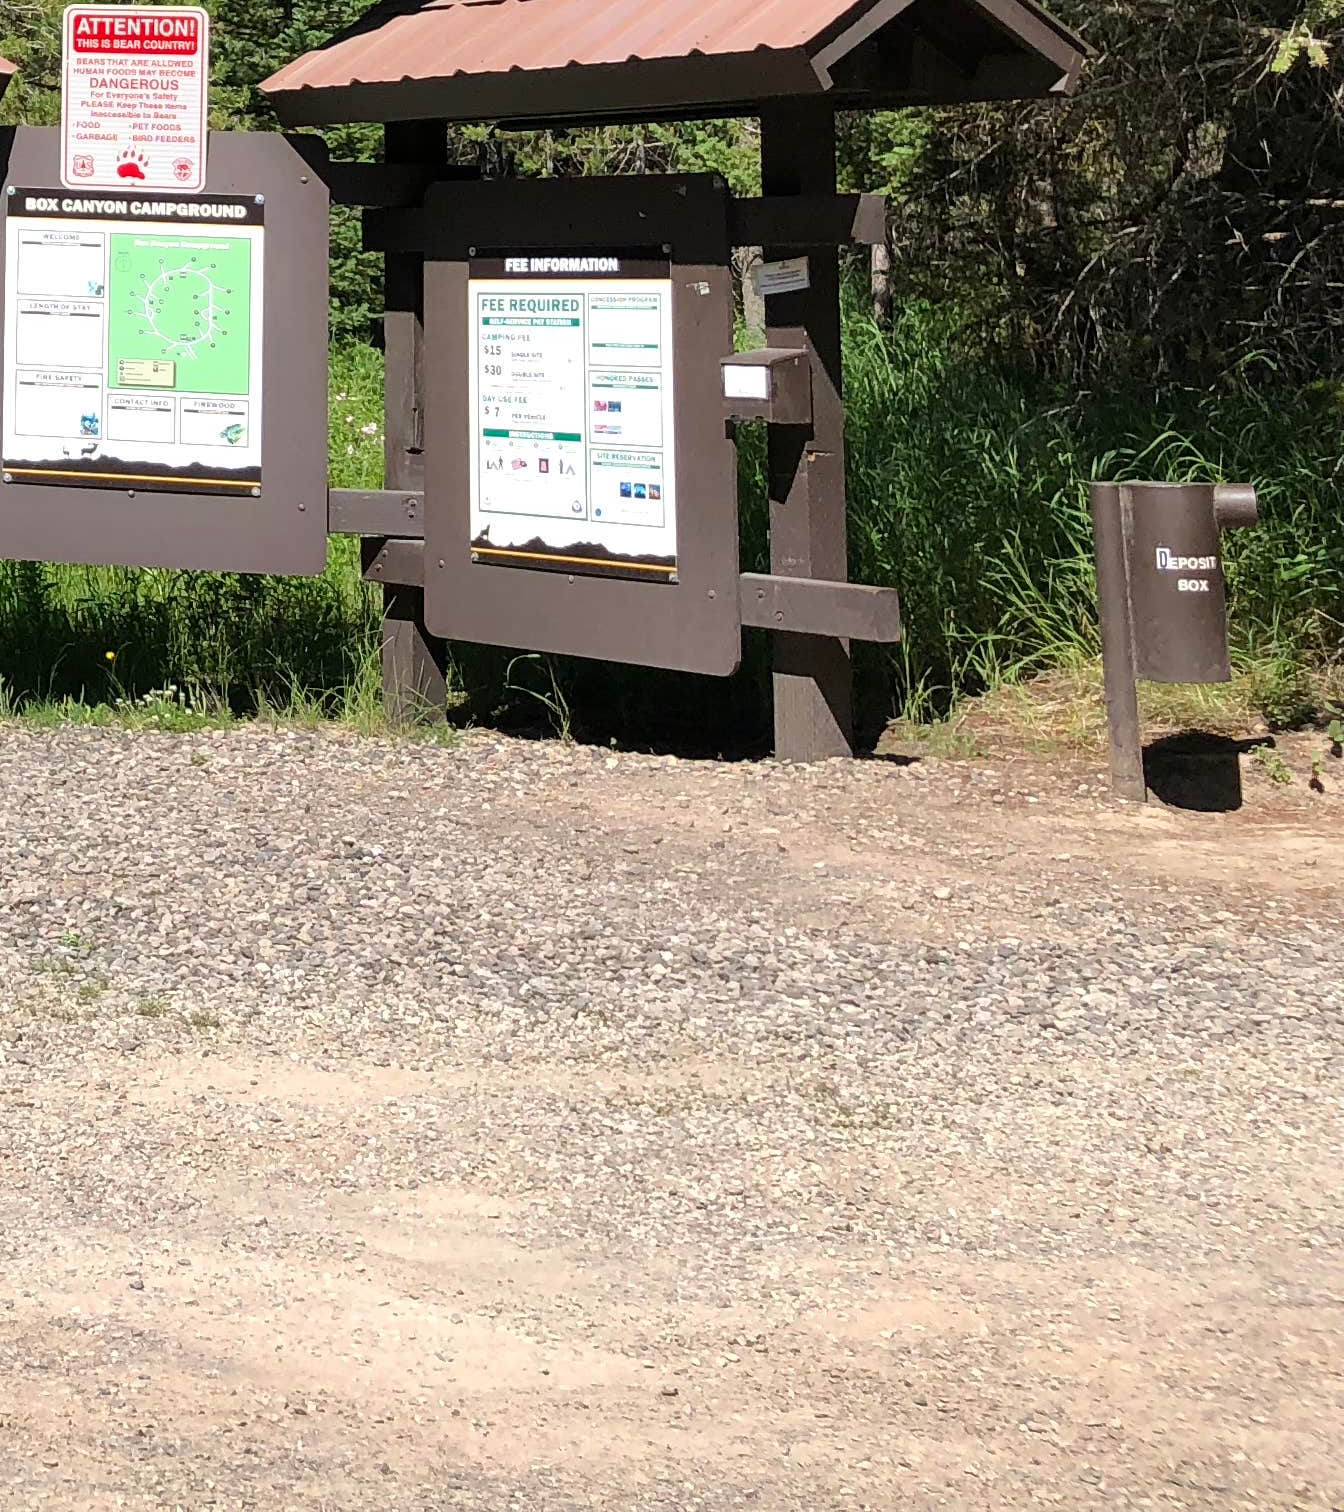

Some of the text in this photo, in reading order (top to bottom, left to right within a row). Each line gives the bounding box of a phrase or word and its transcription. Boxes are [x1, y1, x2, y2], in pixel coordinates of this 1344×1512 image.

[77, 18, 195, 37] ATTENTION!
[76, 38, 195, 50] THIS IS BEAR COUNTRY!
[90, 78, 179, 90] DANGEROUS
[106, 92, 150, 101] Everyone's
[153, 93, 178, 101] Safety
[117, 102, 137, 110] Keep
[91, 110, 140, 118] Inaccessible
[76, 121, 100, 129] FOOD
[152, 123, 182, 131] FOODS
[76, 133, 117, 141] GARBAGE
[25, 198, 247, 218] BOX CANYON CAMPGROUND
[505, 258, 619, 272] FEE INFORMATION
[482, 299, 579, 313] FEE REQUIRED
[484, 345, 502, 356] $15
[484, 365, 502, 376] $30
[1156, 548, 1216, 569] DEPOSIT
[1177, 579, 1209, 591] BOX
